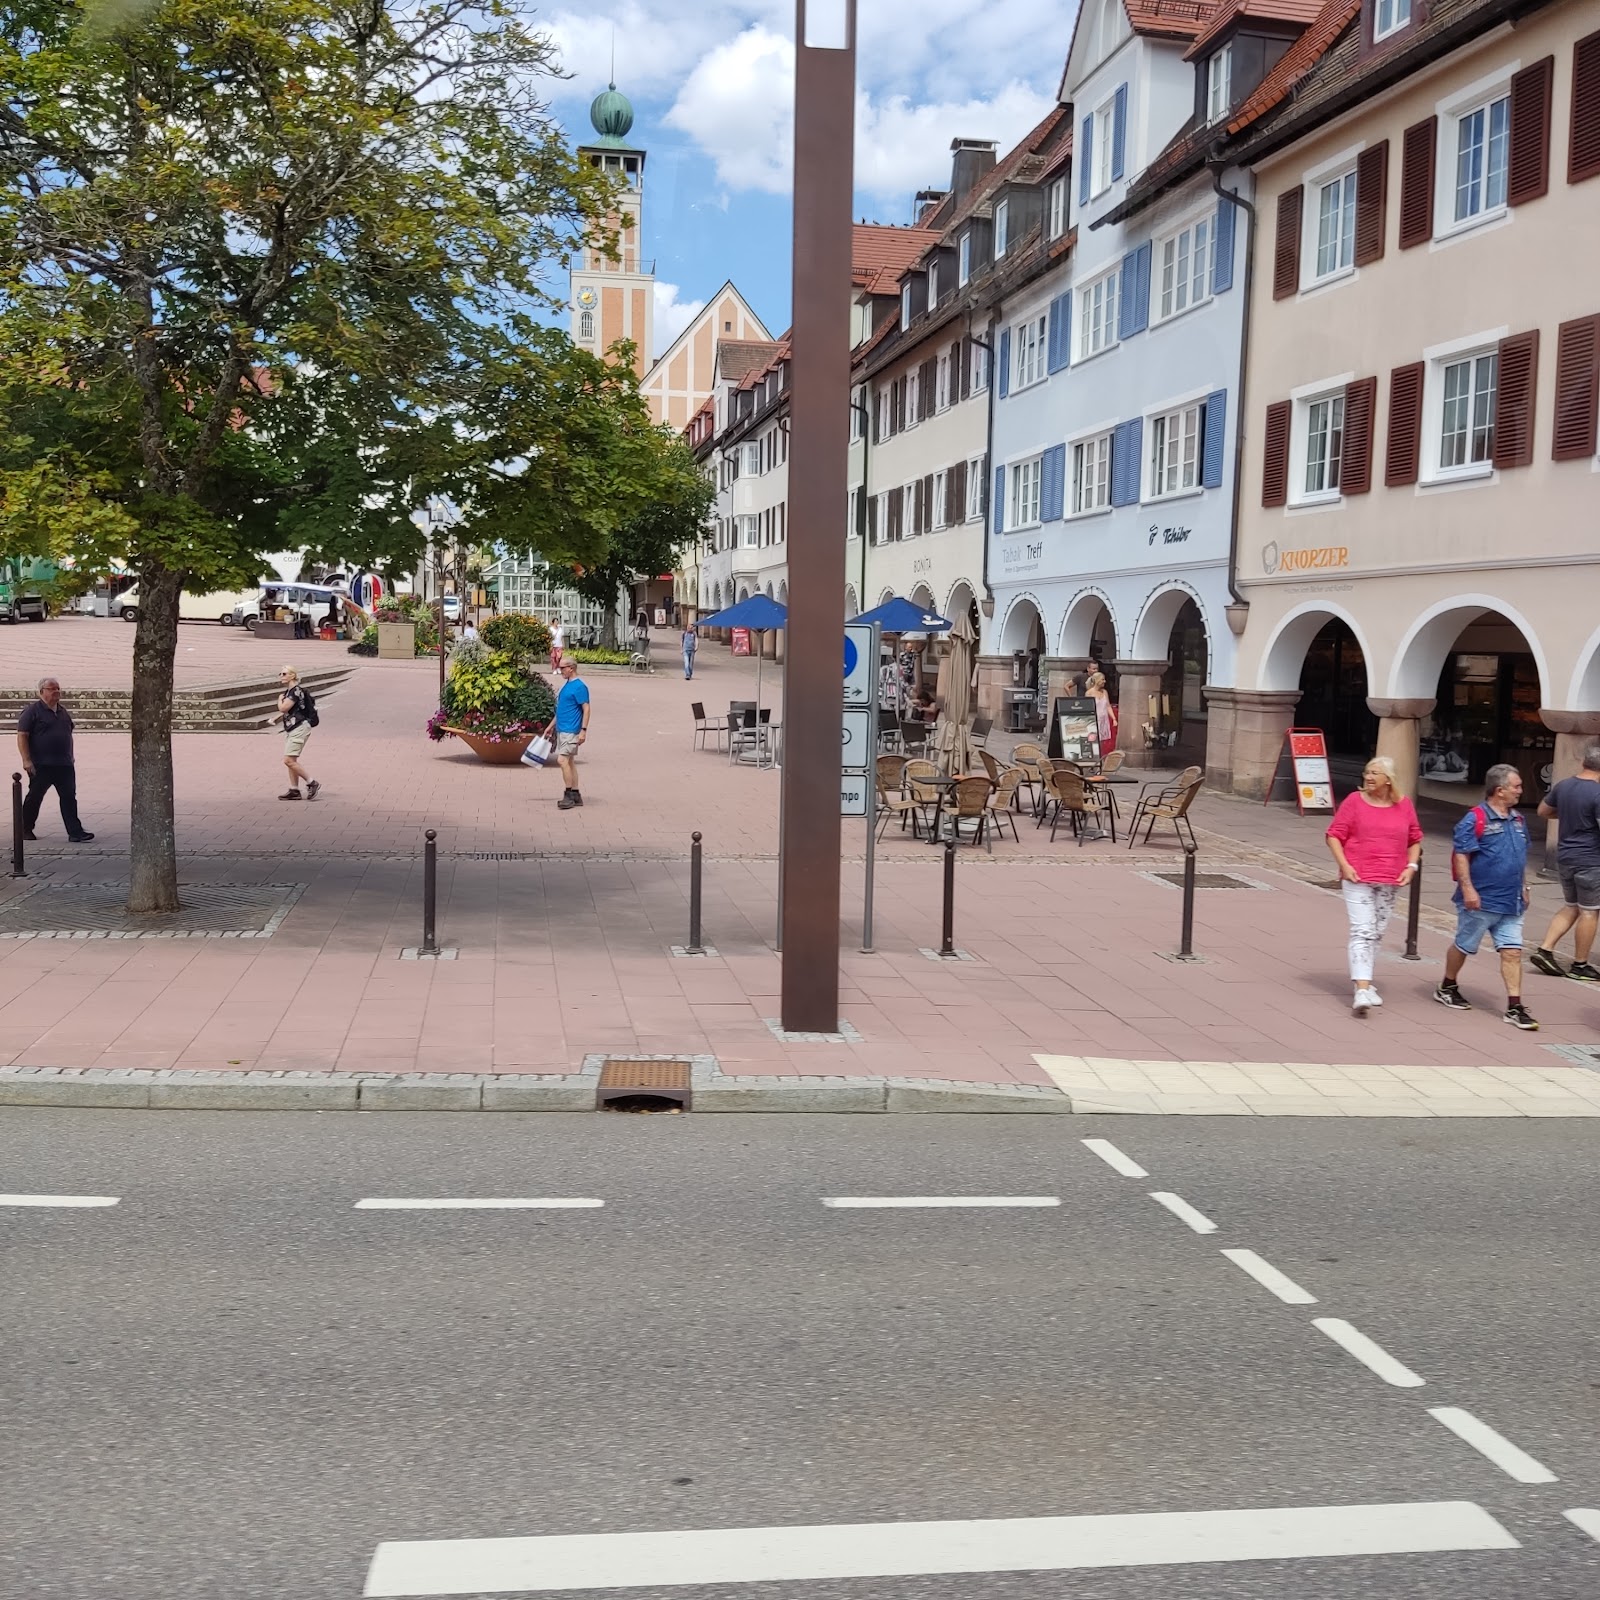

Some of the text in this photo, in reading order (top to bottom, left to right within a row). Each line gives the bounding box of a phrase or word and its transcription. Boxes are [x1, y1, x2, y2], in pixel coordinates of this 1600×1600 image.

[1163, 526, 1192, 544] Tchibo
[1002, 541, 1043, 563] Tabak Treff
[1279, 546, 1349, 571] KNORZER
[840, 792, 860, 804] mpo
